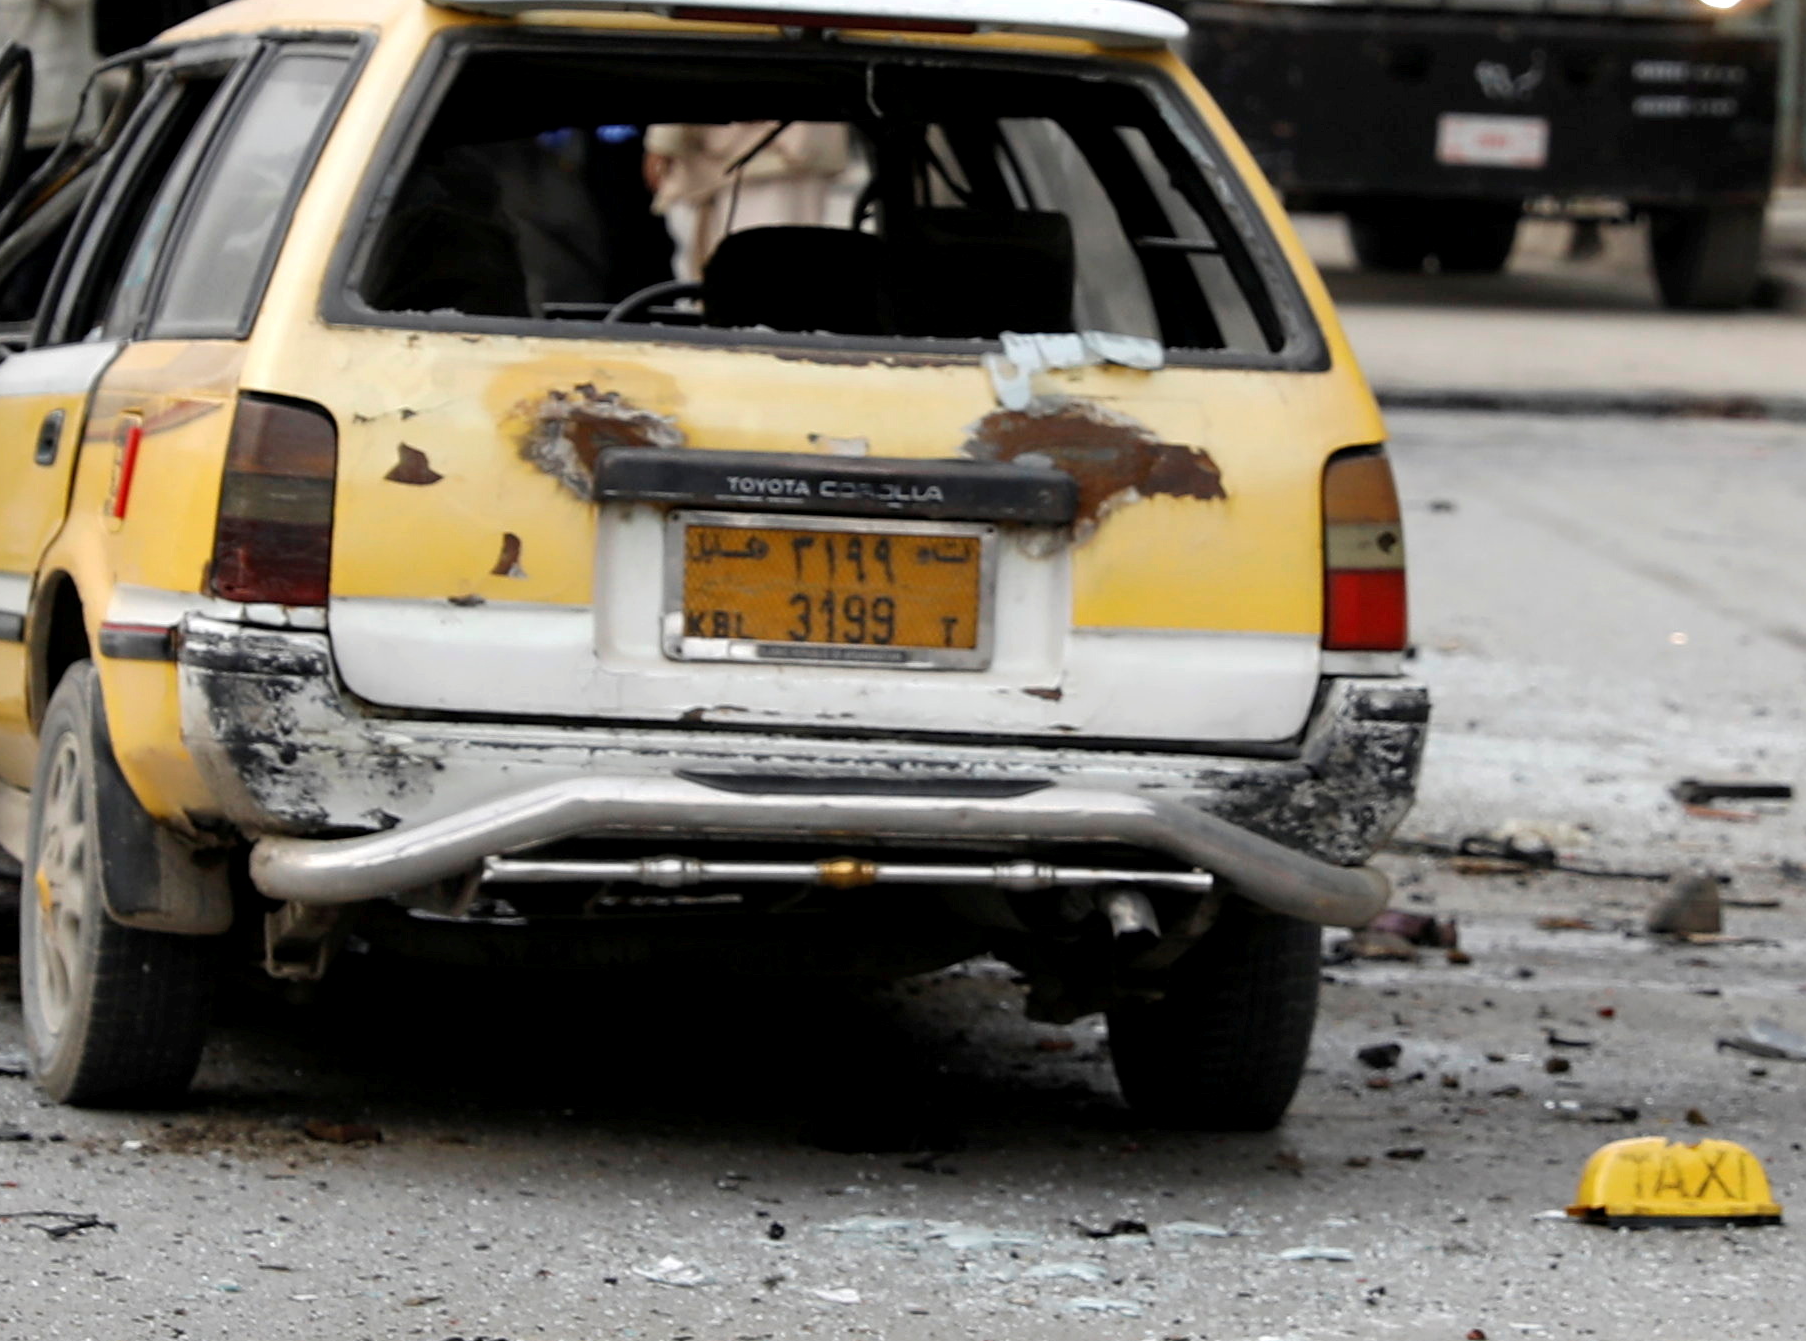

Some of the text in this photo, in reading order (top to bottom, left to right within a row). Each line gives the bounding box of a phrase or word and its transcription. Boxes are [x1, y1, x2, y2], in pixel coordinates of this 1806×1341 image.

[725, 475, 811, 497] TOYOTA
[686, 589, 959, 647] KBL 3199 T
[1618, 1149, 1749, 1200] TAXI
